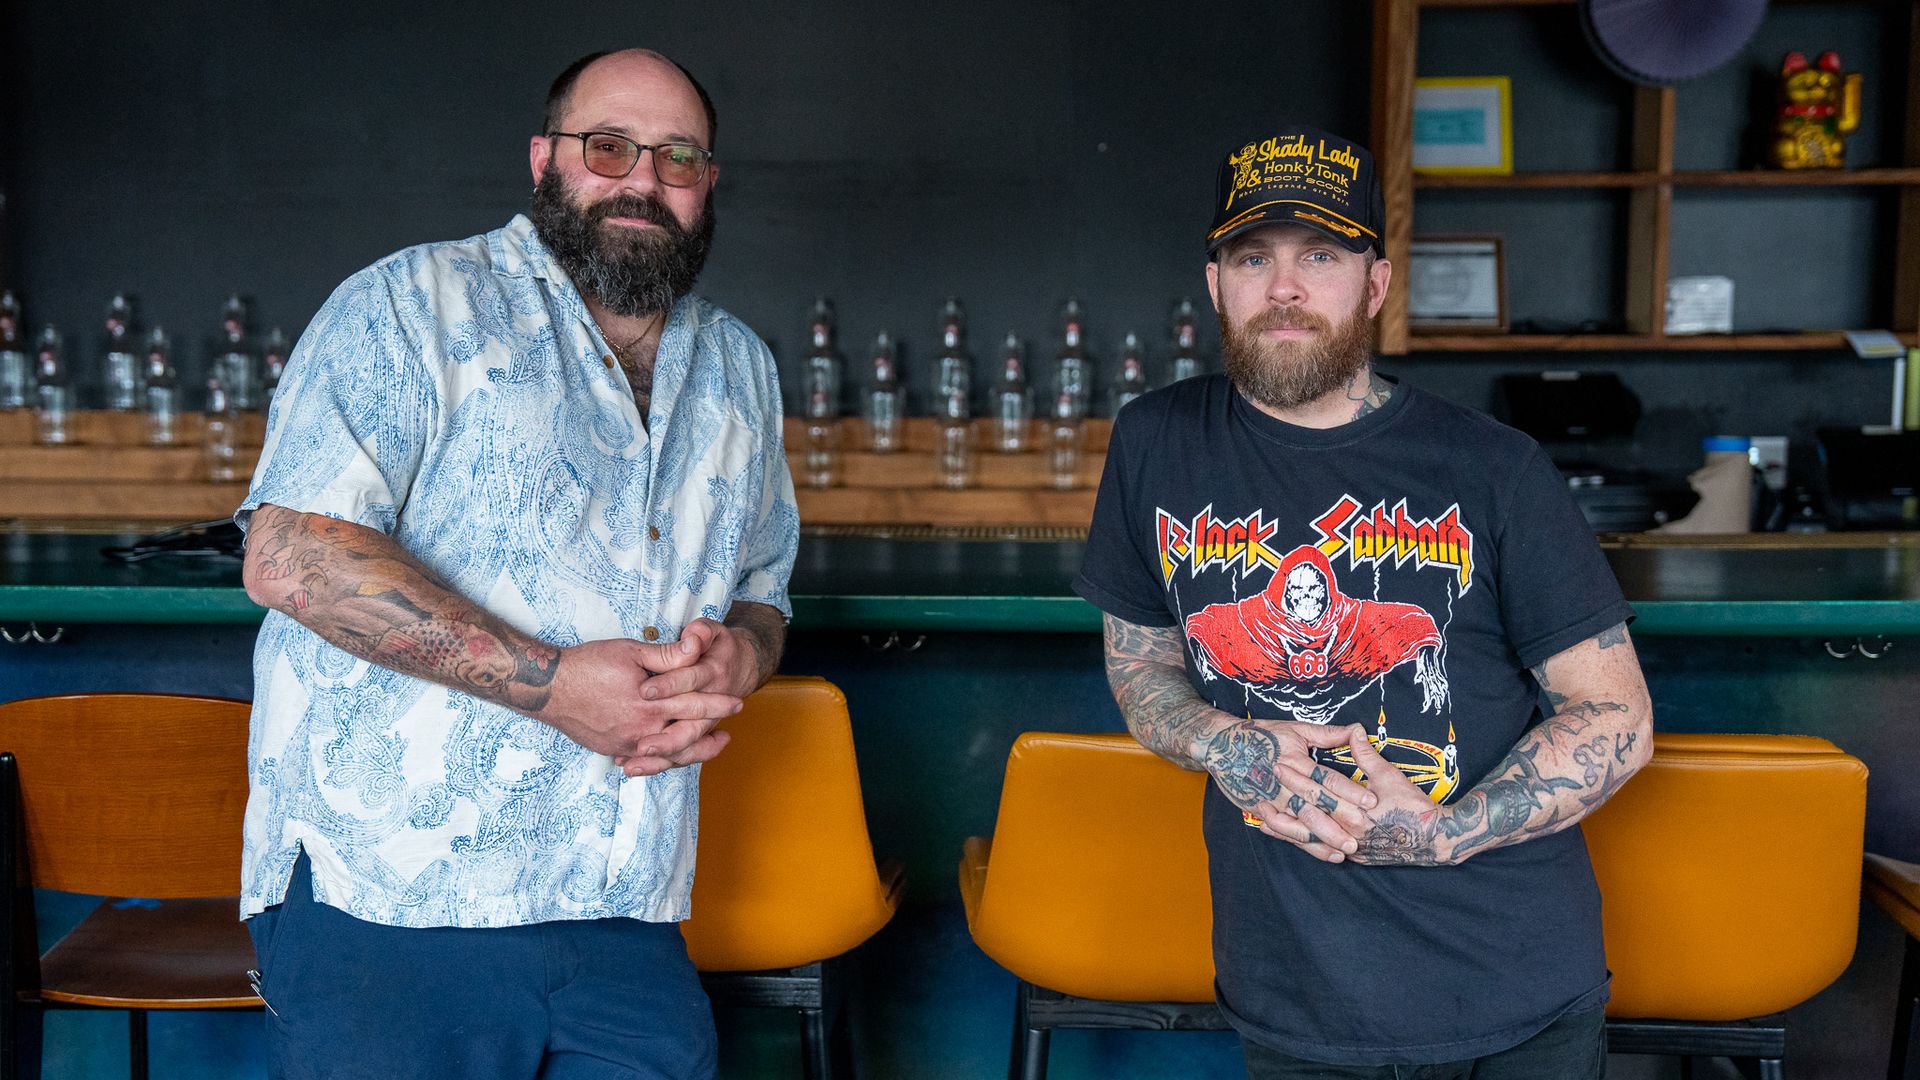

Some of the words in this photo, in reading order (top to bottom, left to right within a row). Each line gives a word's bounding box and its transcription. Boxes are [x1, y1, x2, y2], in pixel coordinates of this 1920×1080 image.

[1256, 134, 1315, 165] Shady
[1319, 139, 1360, 181] Lady
[1246, 169, 1262, 188] &
[1264, 175, 1302, 183] BOOT
[1305, 177, 1349, 197] SCOOT
[1289, 650, 1328, 678] 666
